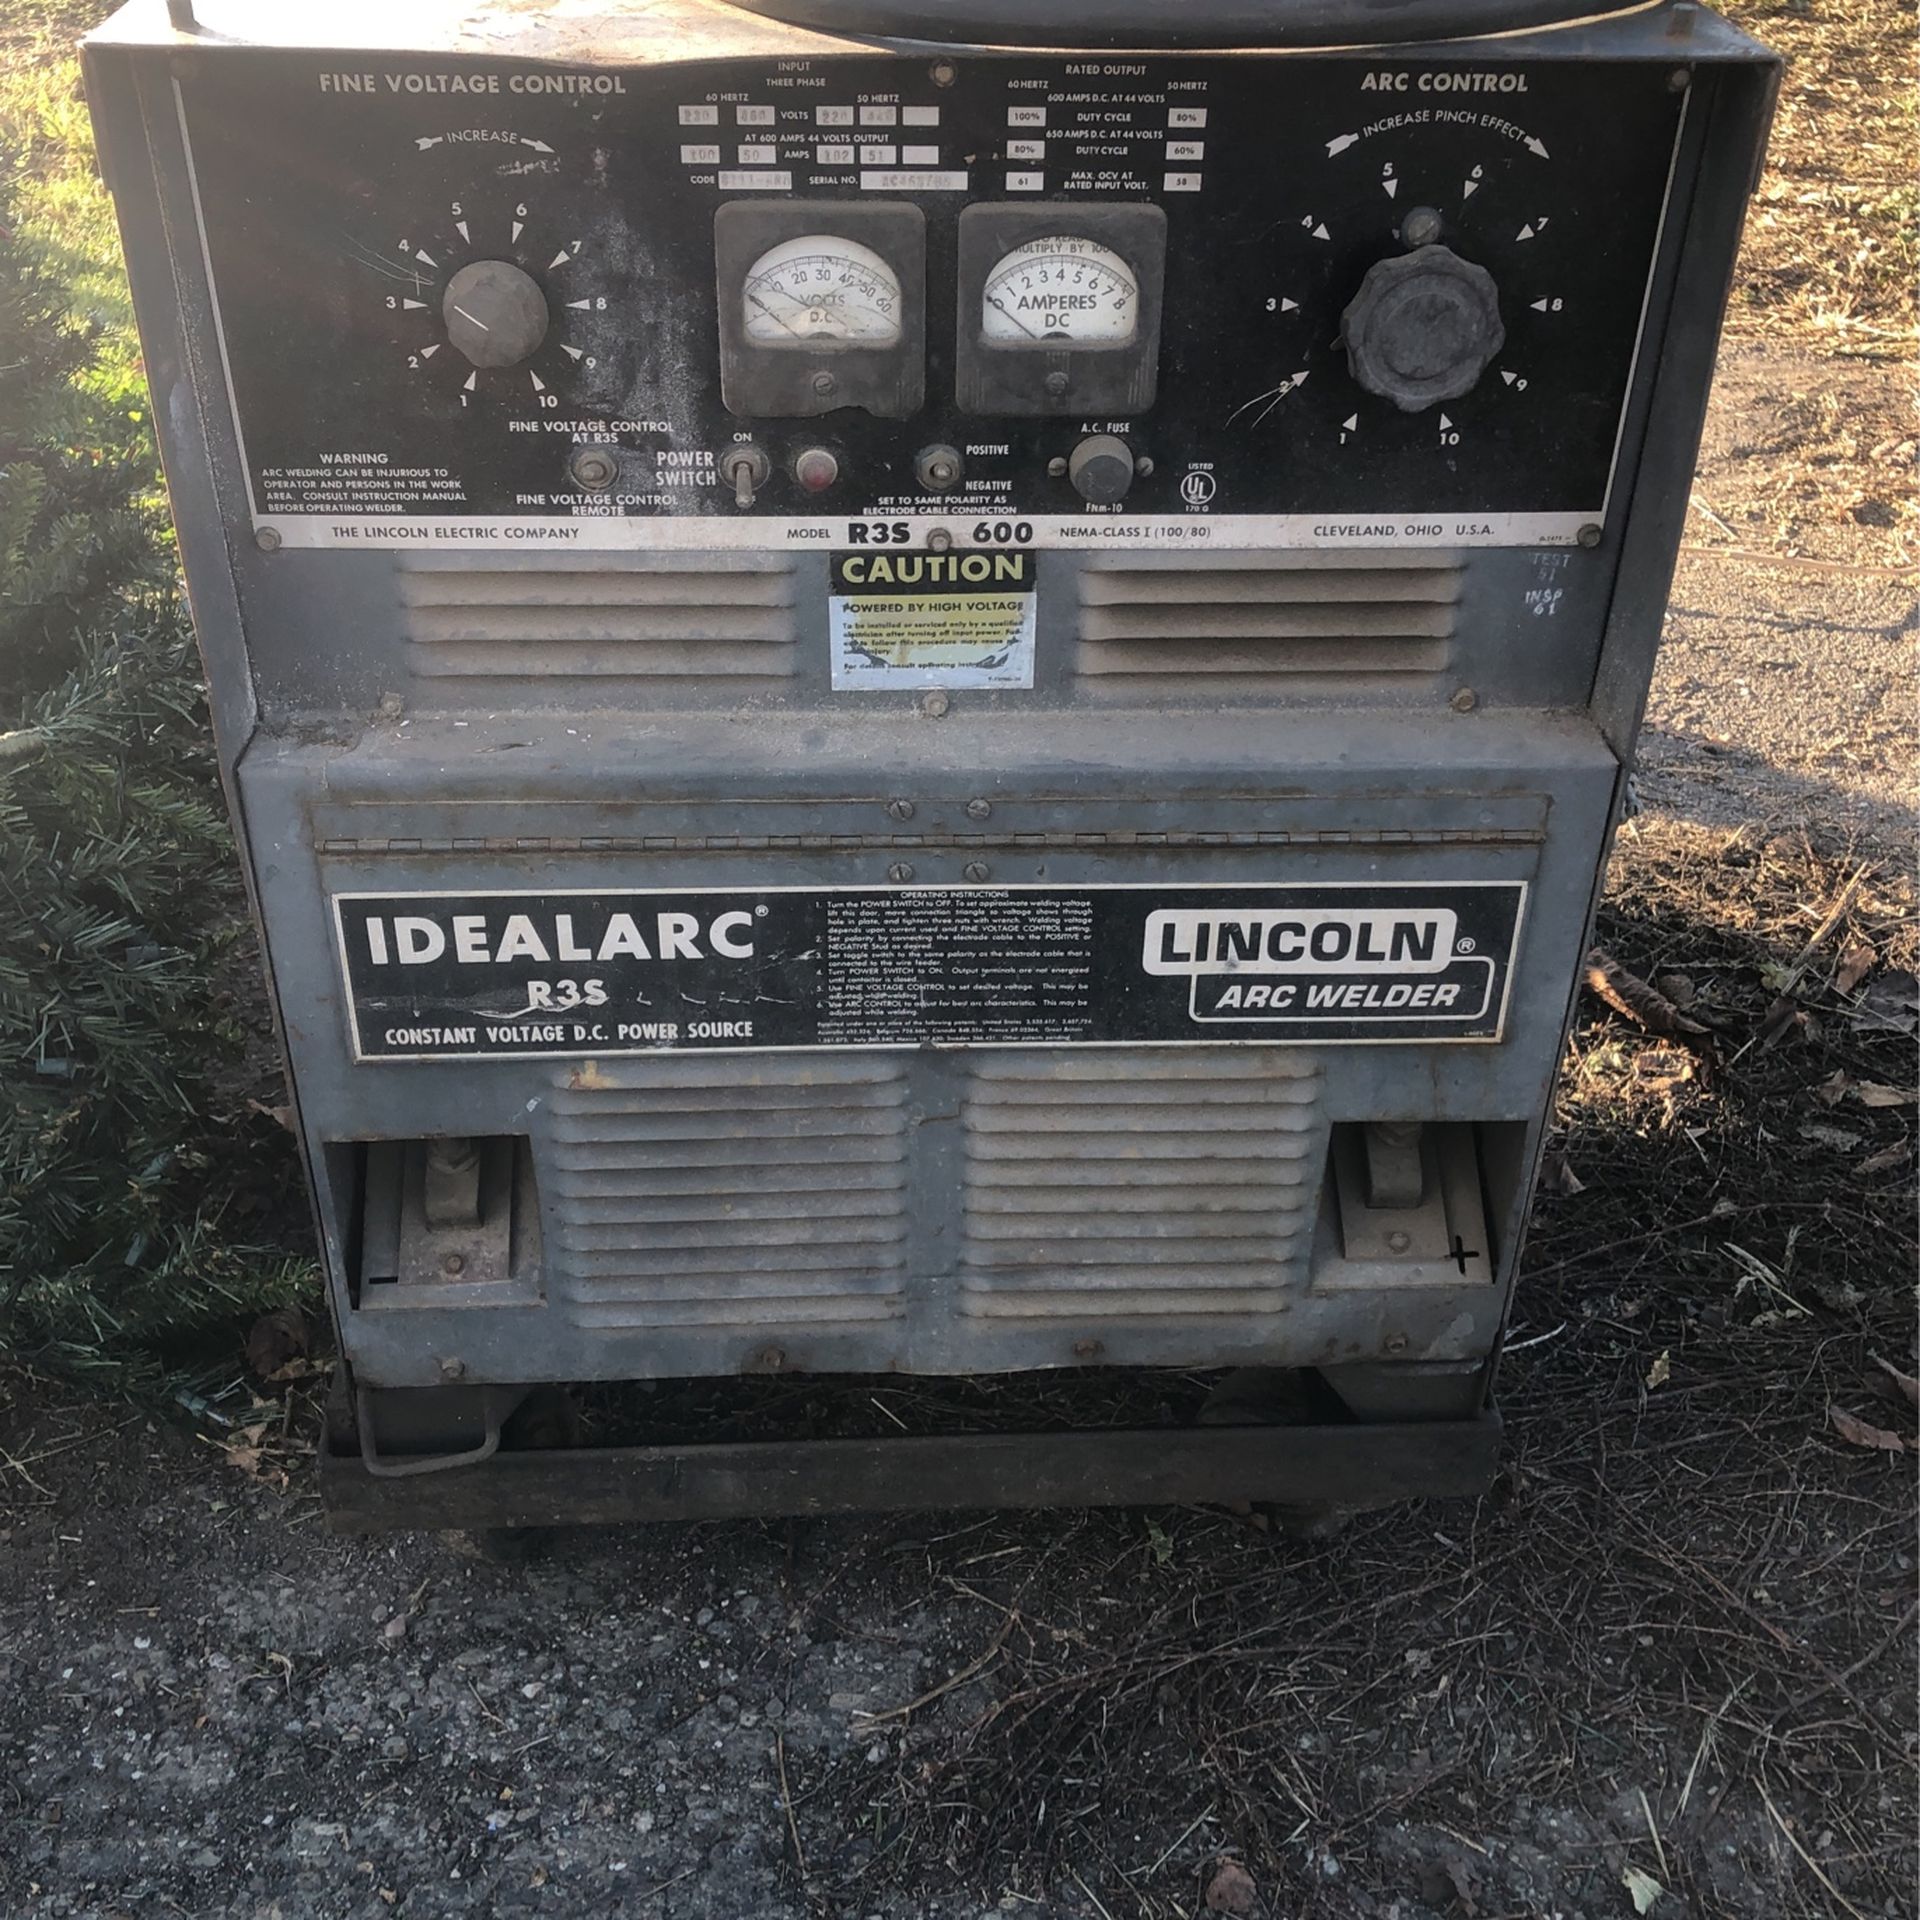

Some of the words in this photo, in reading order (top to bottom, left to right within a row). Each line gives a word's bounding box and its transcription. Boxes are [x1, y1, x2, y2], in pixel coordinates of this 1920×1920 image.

[778, 62, 810, 71] INPUT
[1066, 64, 1100, 75] RATED
[1103, 64, 1147, 75] OUTPUT
[319, 74, 376, 94] FINE
[384, 74, 500, 94] VOLTAGE
[509, 74, 626, 94] CONTROL
[766, 78, 794, 87] THREE
[797, 78, 826, 87] PHASE
[1008, 80, 1019, 88] 60
[1020, 80, 1048, 88] HERTZ
[1168, 82, 1178, 90] 50
[1179, 82, 1207, 90] HERTZ
[1361, 73, 1409, 92] ARC
[1418, 73, 1528, 92] CONTROL
[706, 94, 718, 102] 60
[720, 94, 749, 102] HERTZ
[857, 94, 868, 102] 50
[871, 94, 899, 102] HERTZ
[781, 112, 809, 120] VOLTS
[1014, 112, 1040, 121] 100%
[1077, 113, 1101, 122] DUTY
[1104, 113, 1131, 122] CYCLE
[1363, 110, 1430, 138] INCREASE
[1435, 110, 1477, 124] PINCH
[1480, 114, 1526, 142] EFFECT
[447, 129, 518, 145] INCREASE
[745, 134, 757, 143] AT
[760, 134, 776, 143] 600
[780, 134, 805, 143] AMPS
[808, 134, 819, 143] 44
[823, 134, 850, 143] VOLTS
[854, 134, 889, 143] OUTPUT
[784, 151, 810, 159] AMPS
[1076, 146, 1101, 155] DUTY
[1100, 146, 1128, 155] CYCLE
[1383, 163, 1393, 176] 5
[1472, 165, 1483, 179] 6
[690, 176, 715, 184] CODE
[809, 176, 838, 185] SERIAL
[841, 176, 858, 185] NO.
[1071, 171, 1096, 180] MAX.
[1100, 171, 1119, 180] OCV
[1121, 171, 1133, 180] AT
[1018, 177, 1029, 186] 61
[1064, 181, 1092, 190] RATED
[1095, 181, 1122, 190] INPUT
[1123, 181, 1149, 190] VOLT.
[451, 203, 462, 216] 5
[516, 203, 527, 216] 6
[1302, 215, 1313, 228] 4
[1538, 217, 1549, 231] 7
[398, 239, 409, 253] 4
[571, 241, 582, 254] 7
[386, 297, 396, 310] 3
[596, 298, 607, 310] 8
[1017, 295, 1097, 310] AMPERES
[1266, 298, 1277, 312] 3
[1551, 298, 1563, 312] 8
[1045, 313, 1070, 328] DC
[407, 356, 419, 369] 2
[585, 356, 597, 369] 9
[1517, 379, 1528, 392] 9
[538, 395, 558, 408] 10
[509, 422, 539, 432] FINE
[543, 422, 606, 432] VOLTAGE
[610, 422, 674, 432] CONTROL
[1081, 423, 1101, 433] A.C.
[1107, 423, 1130, 433] FUSE
[572, 433, 589, 443] AT
[593, 433, 619, 443] R3S
[733, 433, 752, 442] ON
[1440, 432, 1460, 445] 10
[966, 445, 1009, 455] POSITIVE
[320, 453, 389, 464] WARNING
[657, 452, 714, 467] POWER
[262, 468, 283, 477] ARC
[286, 468, 332, 477] WELDING
[335, 468, 358, 477] CAN
[361, 468, 373, 477] BE
[376, 468, 431, 477] INJURIOUS
[434, 468, 448, 477] TO
[656, 471, 716, 486] SWITCH
[264, 480, 317, 489] OPERATOR
[320, 480, 342, 489] AND
[345, 480, 390, 489] PERSONS
[394, 480, 405, 489] IN
[408, 480, 428, 489] THE
[430, 480, 462, 489] WORK
[966, 481, 1012, 491] NEGATIVE
[266, 492, 296, 501] AREA.
[302, 492, 349, 501] CONSULT
[352, 492, 419, 501] INSTRUCTION
[422, 492, 467, 501] MANUAL
[516, 495, 545, 505] FINE
[549, 495, 611, 505] VOLTAGE
[615, 495, 679, 505] CONTROL
[878, 496, 896, 505] SET
[899, 496, 912, 505] TO
[914, 496, 941, 505] SAME
[945, 496, 990, 505] POLARITY
[993, 496, 1007, 505] AS
[268, 503, 305, 513] BEFORE
[306, 503, 363, 513] OPERATING
[364, 503, 406, 513] WELDER.
[572, 506, 625, 516] REMOTE
[863, 506, 916, 515] ELECTRODE
[919, 506, 948, 515] CABLE
[951, 506, 1017, 515] CONNECTION
[332, 526, 359, 538] THE
[364, 526, 429, 539] LINCOLN
[435, 526, 499, 539] ELECTRIC
[504, 527, 580, 539] COMPANY
[787, 528, 831, 539] MODEL
[848, 522, 911, 544] R3S
[973, 522, 1034, 543] 600
[1060, 527, 1140, 537] NEMA-CLASS
[1154, 526, 1211, 539] (100/80)
[1313, 525, 1398, 539] CLEVELAND,
[1404, 524, 1443, 536] OHIO
[1456, 524, 1494, 536] U.S.A.
[842, 554, 1024, 584] CAUTION
[843, 602, 904, 613] POWERED
[908, 602, 925, 612] BY
[929, 602, 962, 611] HIGH
[900, 891, 947, 899] OPERATING
[950, 891, 1009, 899] INSTRUCTIONS
[1160, 921, 1438, 963] LINCOLN
[527, 980, 606, 1008] R3S
[1215, 986, 1297, 1009] ARC
[1306, 984, 1461, 1008] WELDER
[385, 1025, 477, 1045] CONSTANT
[486, 1025, 565, 1043] VOLTAGE
[573, 1025, 609, 1042] D.C.
[618, 1022, 678, 1040] POWER
[687, 1020, 753, 1038] SOURCE
